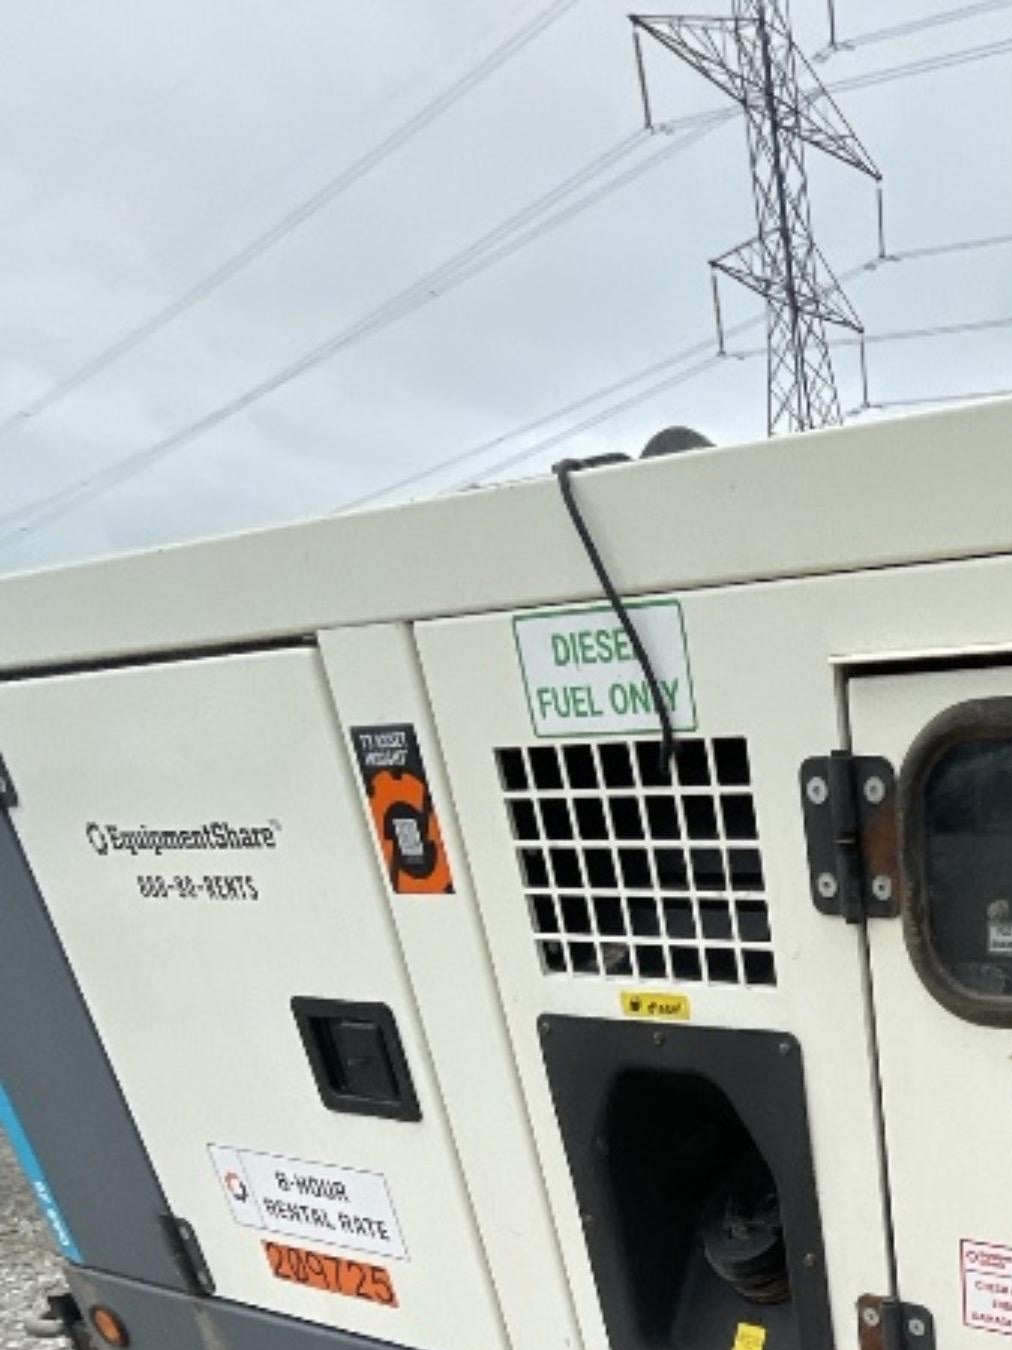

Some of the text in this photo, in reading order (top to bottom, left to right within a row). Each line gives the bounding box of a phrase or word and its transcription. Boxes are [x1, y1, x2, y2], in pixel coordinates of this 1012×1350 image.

[551, 628, 643, 668] DIESE
[536, 678, 678, 720] FUEL ONY
[104, 821, 277, 856] EquipmentShare
[262, 1197, 392, 1242] RENTAL RATE
